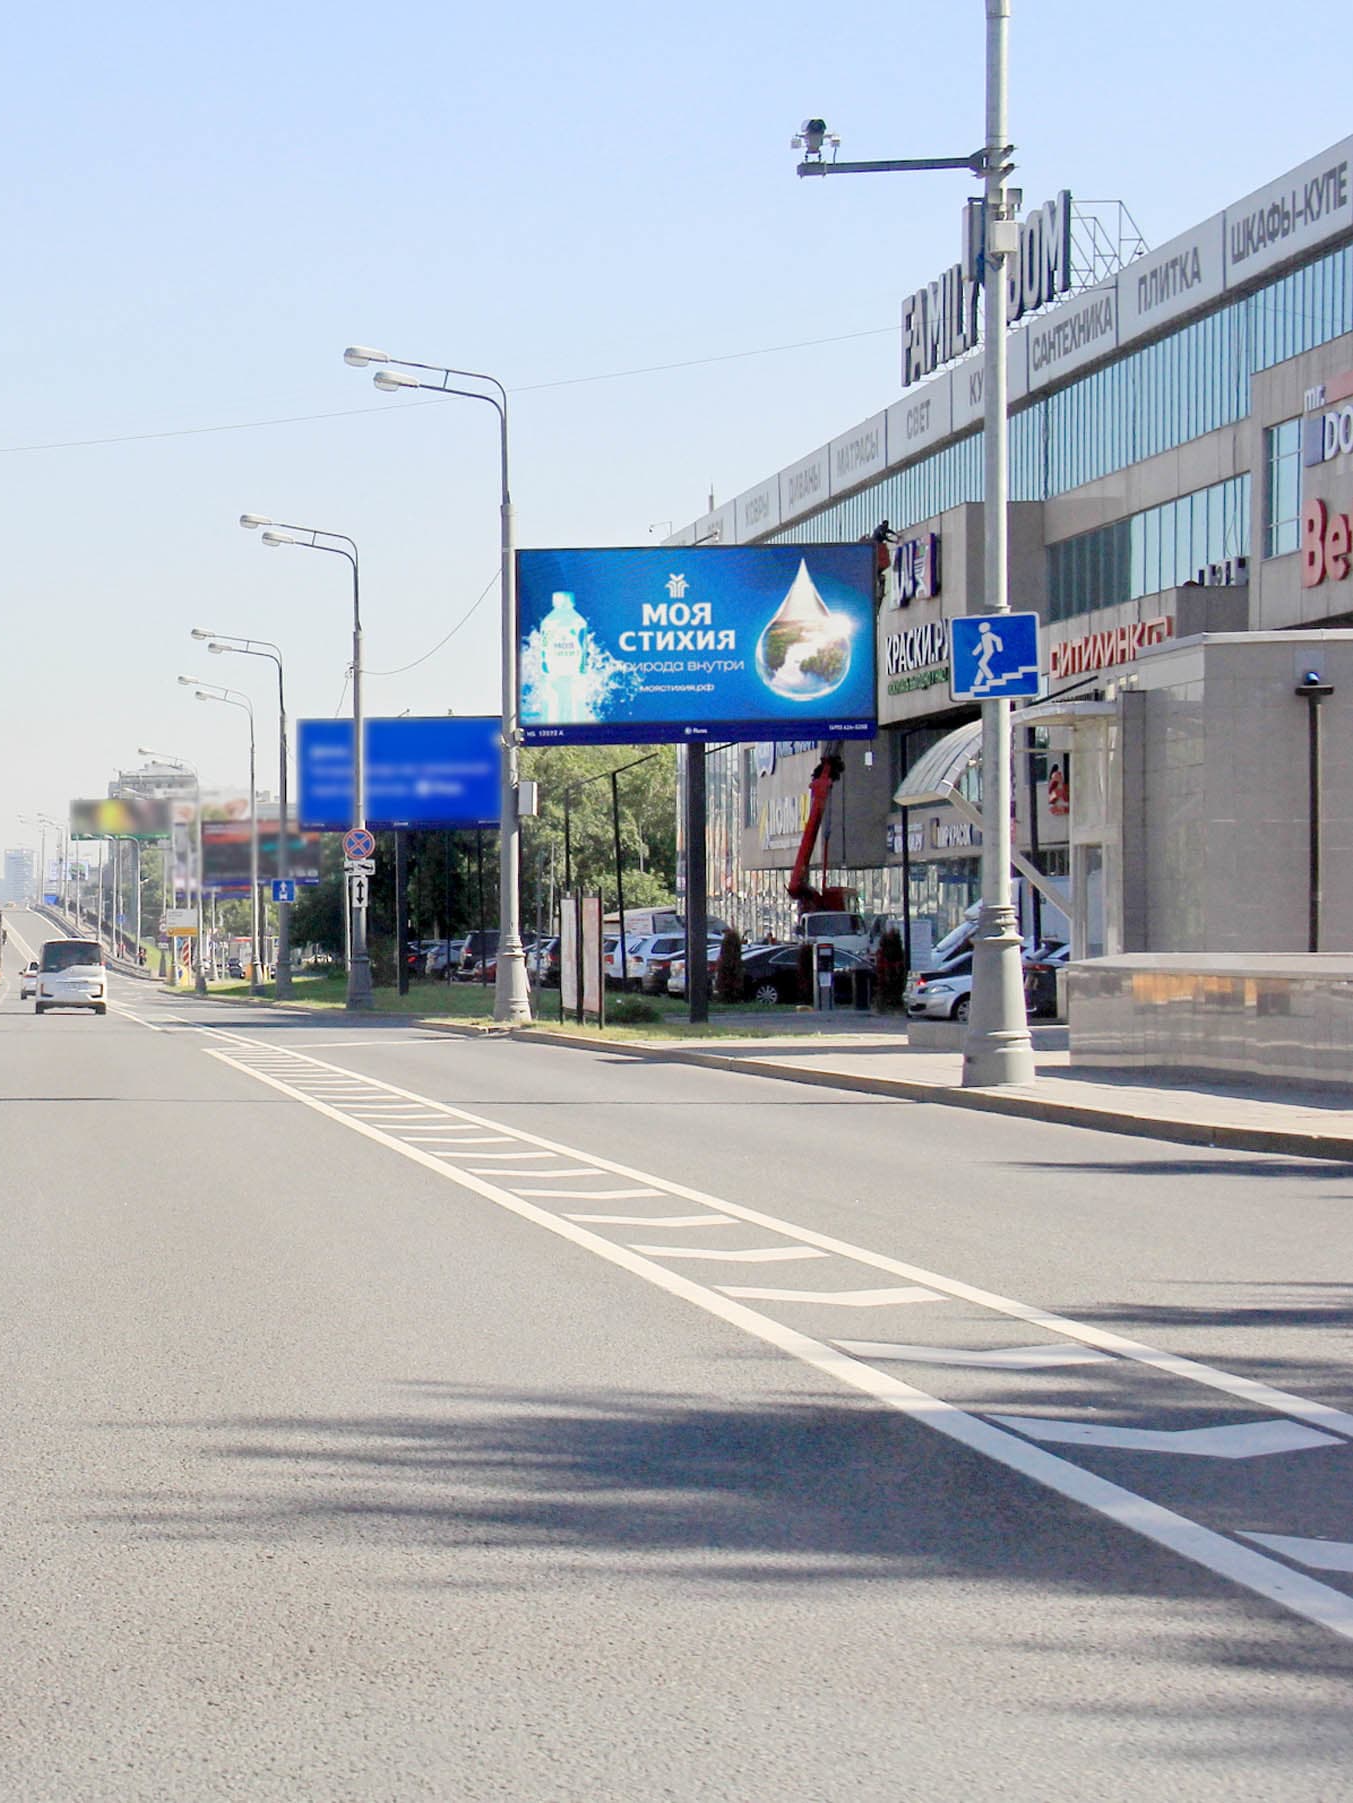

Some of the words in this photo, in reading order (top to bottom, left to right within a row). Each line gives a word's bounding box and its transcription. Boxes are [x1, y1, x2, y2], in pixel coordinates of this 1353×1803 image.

[1231, 160, 1348, 265] ШКАФЫ-КУПЕ
[1138, 246, 1202, 315] ПЛИТКА
[902, 263, 980, 387] FAMILY
[1032, 296, 1114, 372] САНТЕХНИКА
[906, 398, 932, 441] СВЕТ
[618, 629, 736, 652] СТИХИЯ
[642, 602, 713, 627] МОЯ
[687, 659, 745, 673] внутри
